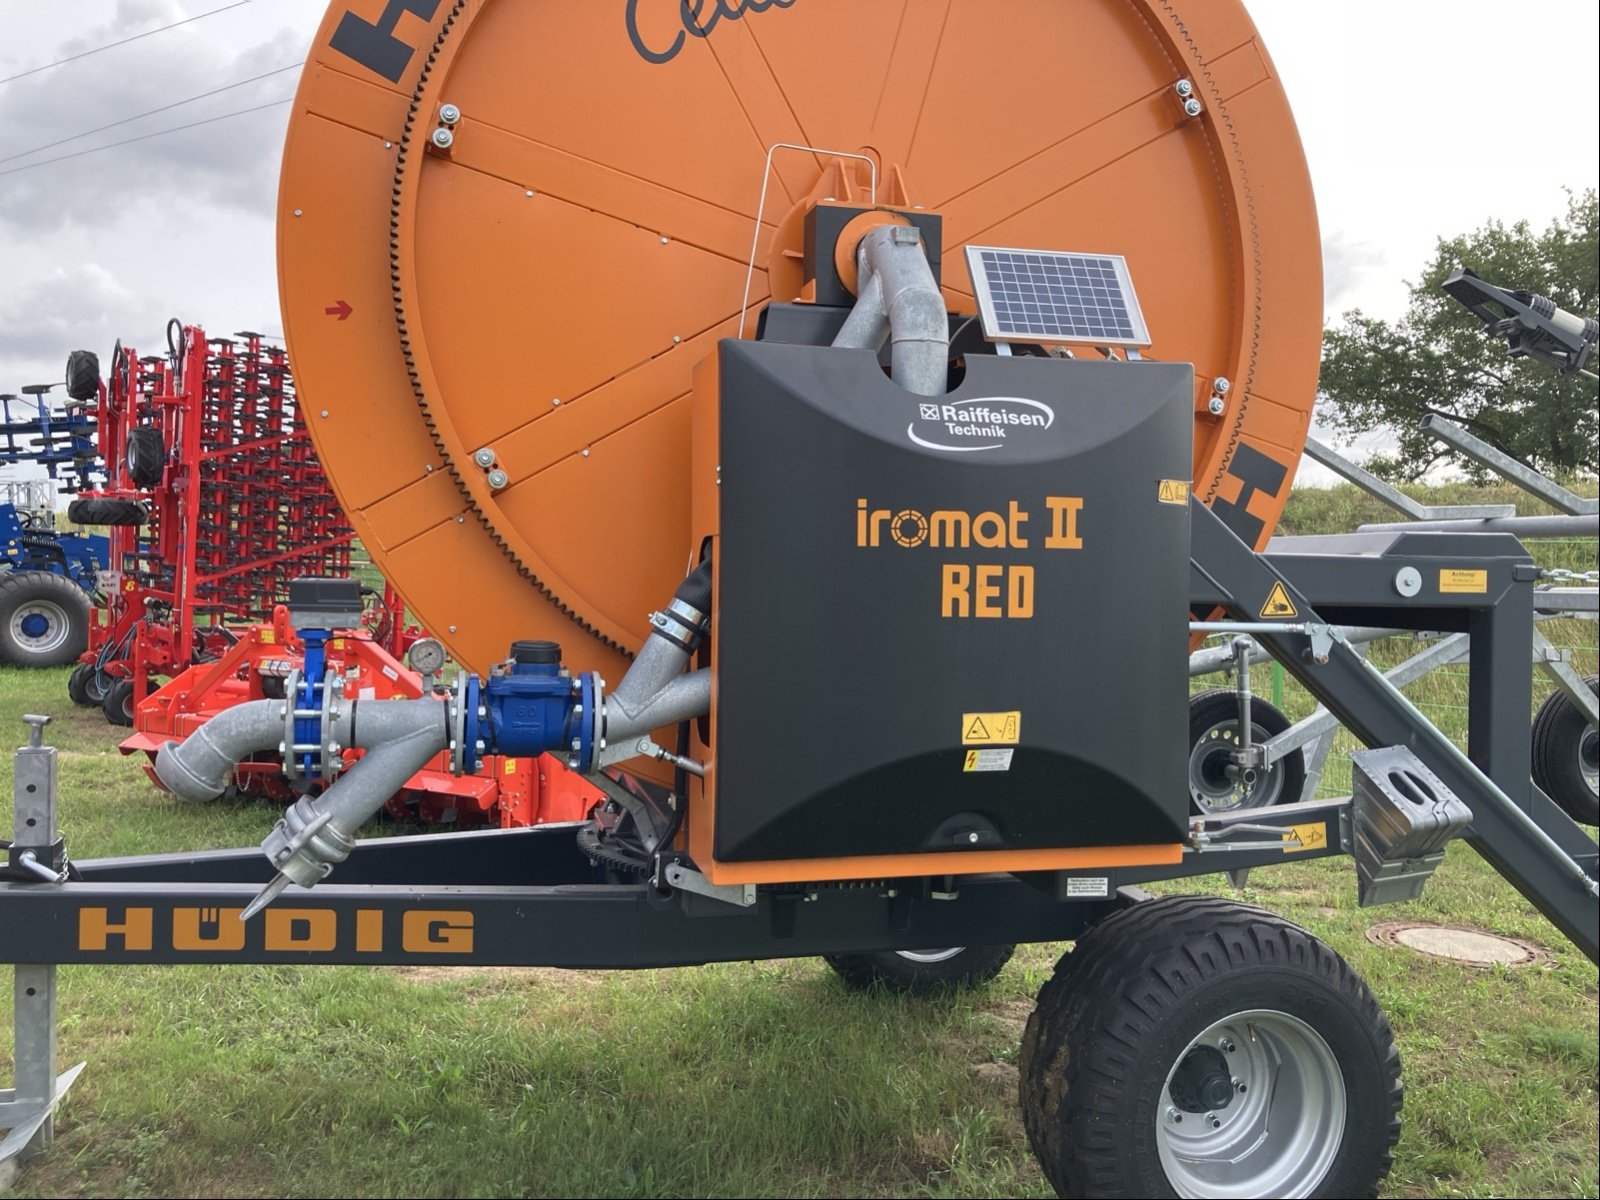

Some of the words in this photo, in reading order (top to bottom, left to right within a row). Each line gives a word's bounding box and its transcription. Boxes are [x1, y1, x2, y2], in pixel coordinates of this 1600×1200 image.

[941, 405, 1046, 426] Raiffeisen
[944, 422, 1007, 437] Technik
[856, 498, 1029, 549] iromat
[1045, 496, 1084, 550] II
[941, 564, 1035, 619] RED
[78, 906, 474, 954] HÜDIG
